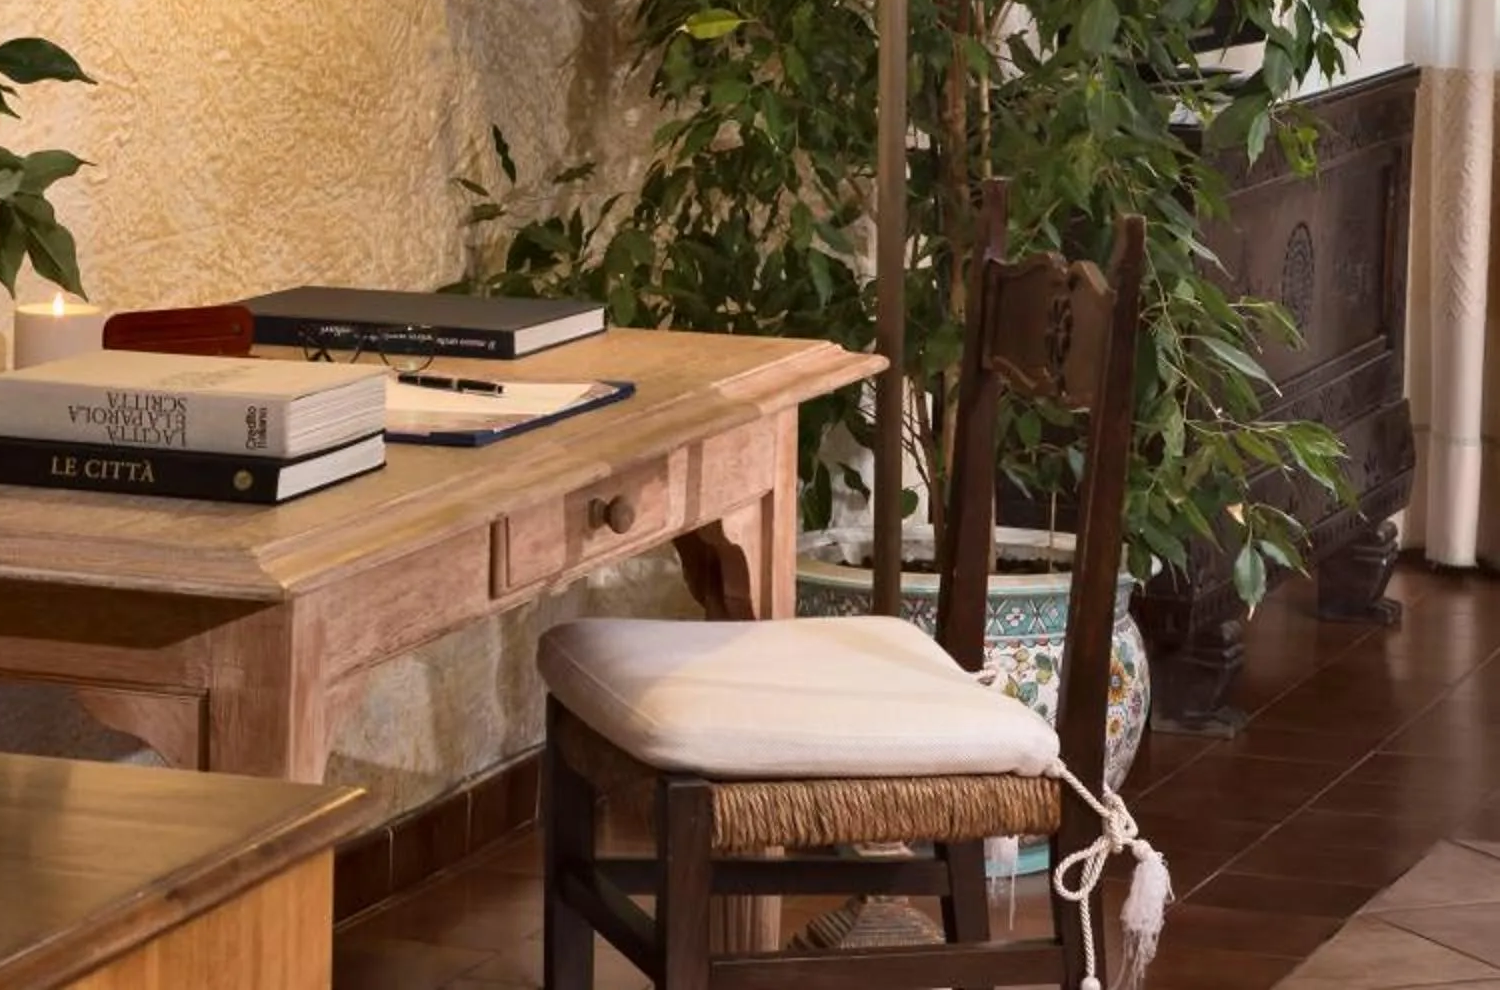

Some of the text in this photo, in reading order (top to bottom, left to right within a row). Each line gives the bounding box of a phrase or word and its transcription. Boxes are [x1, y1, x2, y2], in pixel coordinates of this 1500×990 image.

[107, 392, 188, 413] SCRITTA
[68, 405, 143, 427] PAROLA
[147, 411, 171, 429] LA
[105, 425, 187, 447] LA CITTÀ
[51, 455, 155, 483] LE CITTÀ
